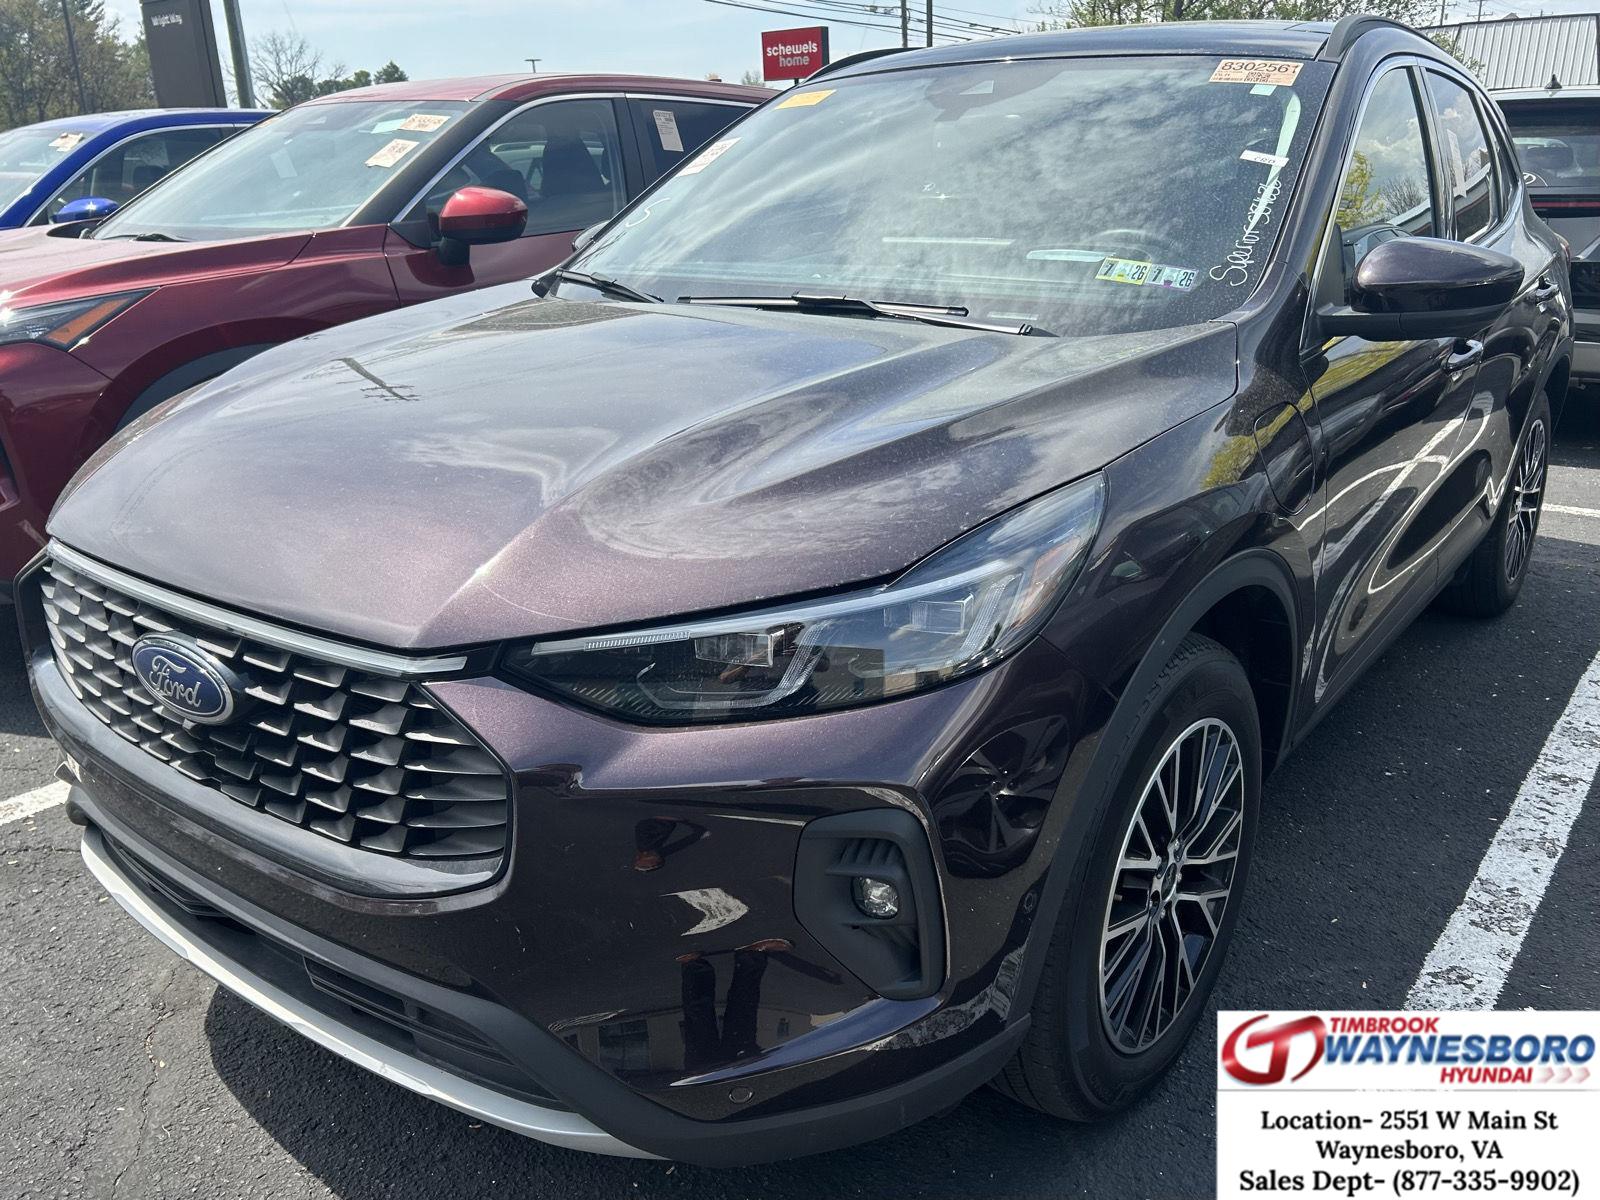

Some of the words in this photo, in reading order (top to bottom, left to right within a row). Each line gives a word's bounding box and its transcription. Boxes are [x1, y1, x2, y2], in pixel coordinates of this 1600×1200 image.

[766, 41, 818, 57] schewels
[779, 55, 810, 68] home
[1221, 61, 1300, 74] 8302561
[1103, 262, 1115, 276] 7
[1131, 265, 1148, 281] 26
[1152, 268, 1163, 282] 7
[1178, 271, 1196, 287] 26
[149, 655, 202, 708] Ford
